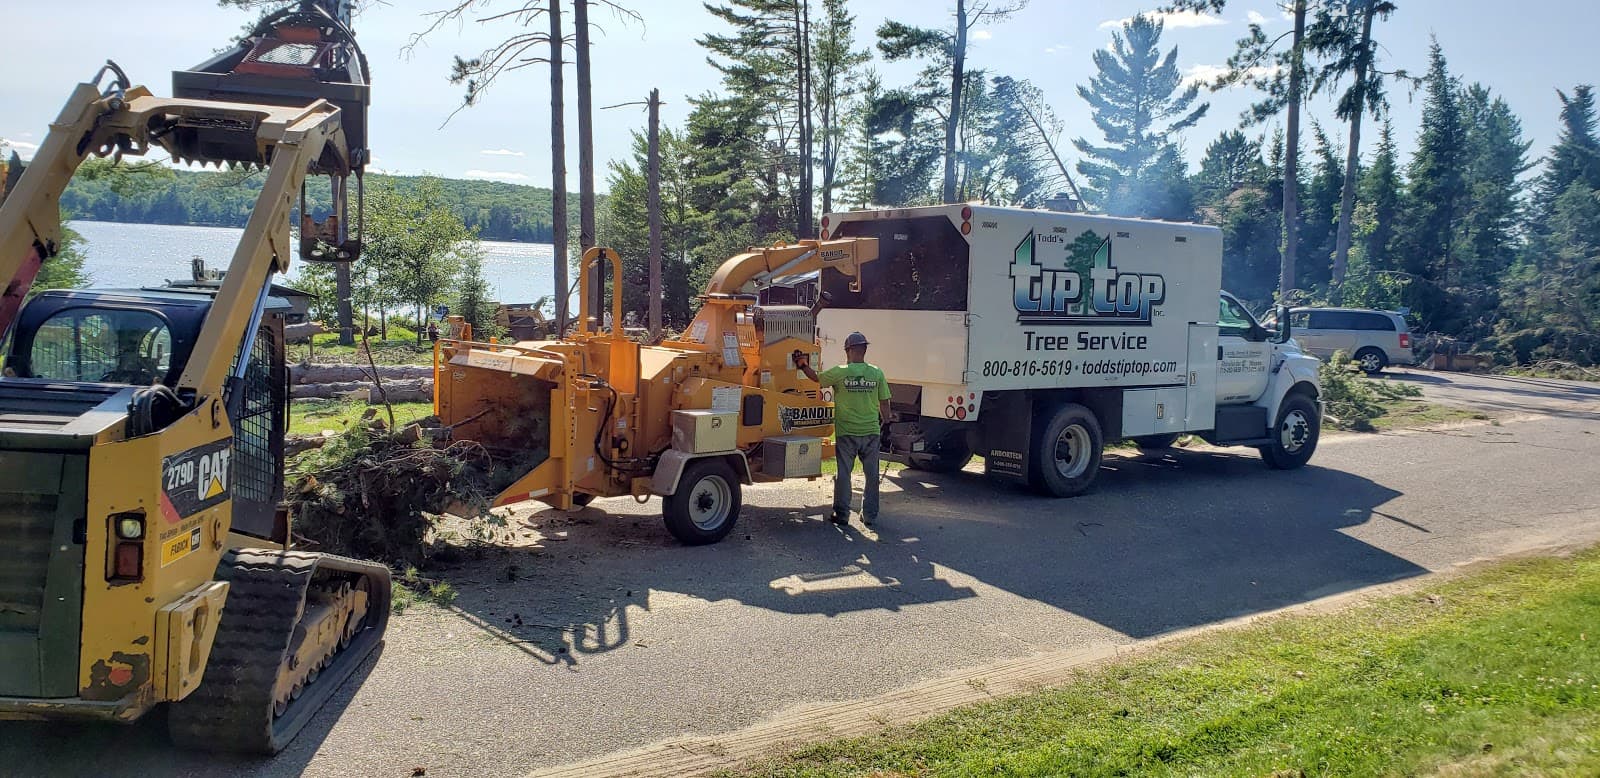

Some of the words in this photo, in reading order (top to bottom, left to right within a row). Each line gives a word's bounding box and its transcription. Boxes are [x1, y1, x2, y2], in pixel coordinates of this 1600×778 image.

[1037, 233, 1064, 244] Todd's
[1008, 227, 1082, 314] tip
[1089, 232, 1166, 322] top
[1153, 308, 1166, 317] Inc.
[1023, 330, 1069, 351] Tree
[1076, 330, 1148, 351] Service
[983, 360, 1072, 377] 800-816-5619
[1082, 359, 1177, 377] toddstiptop.com
[792, 406, 835, 420] BANDIT
[168, 460, 194, 490] 279D
[198, 448, 231, 500] CAT
